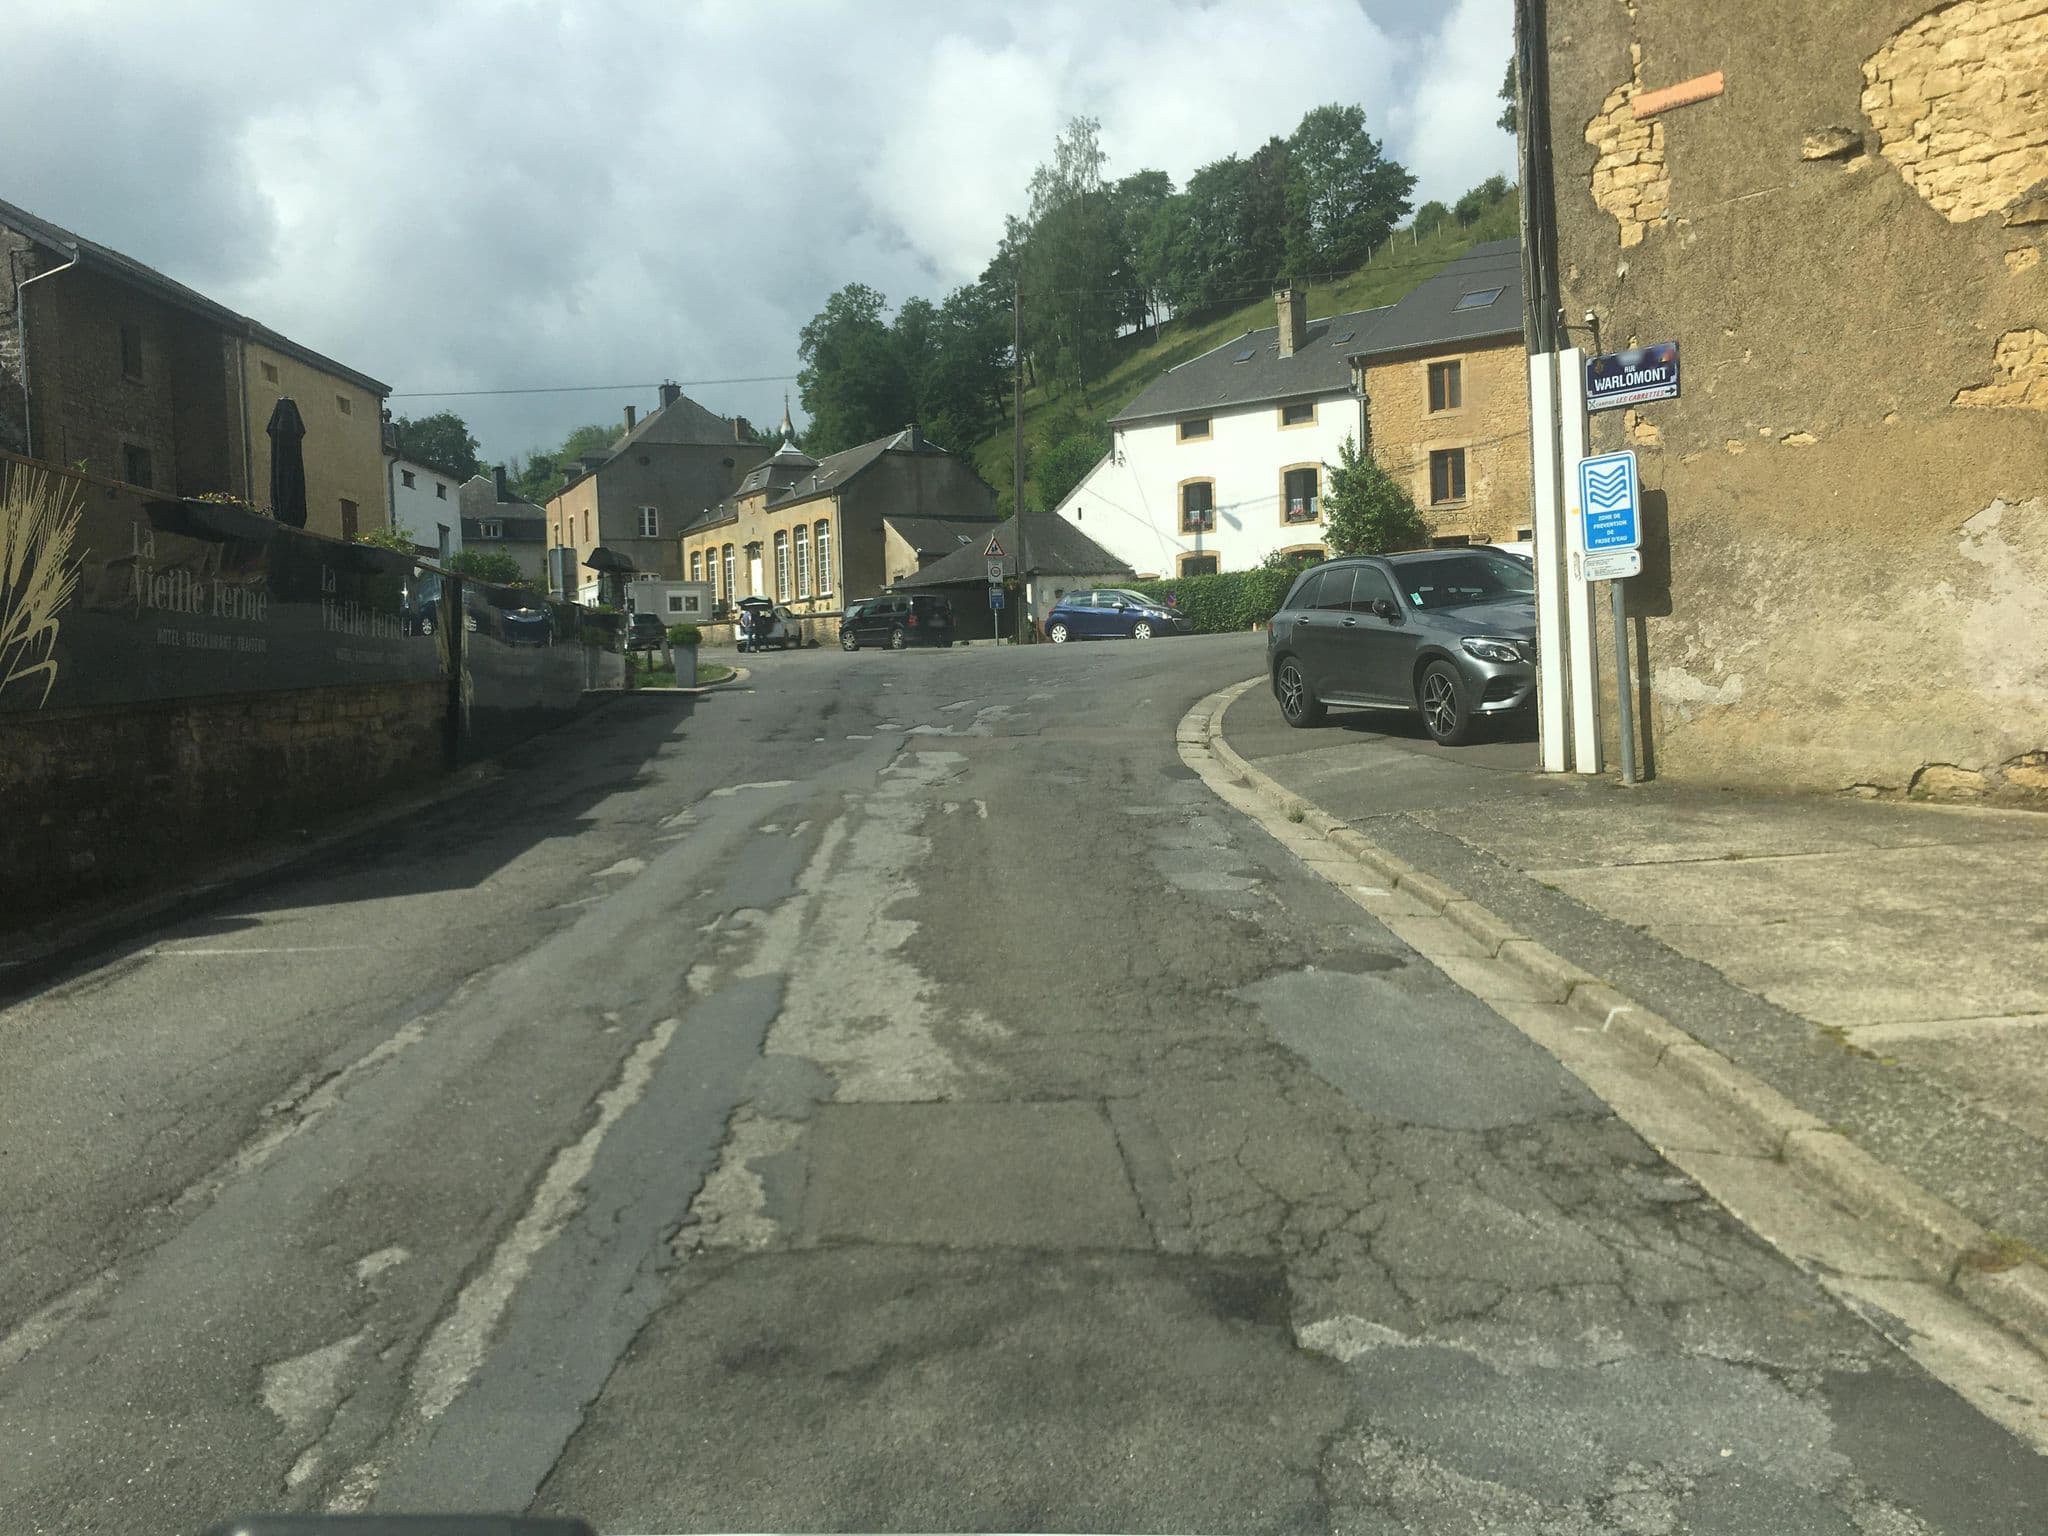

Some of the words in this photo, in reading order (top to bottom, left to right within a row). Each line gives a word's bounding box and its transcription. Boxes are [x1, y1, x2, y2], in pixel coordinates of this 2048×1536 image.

[1595, 367, 1667, 391] WARLOMONT
[1624, 365, 1636, 374] RUE
[1616, 395, 1629, 404] LES
[131, 521, 156, 560] La
[131, 563, 205, 616] Vieille
[212, 577, 268, 623] Ferme
